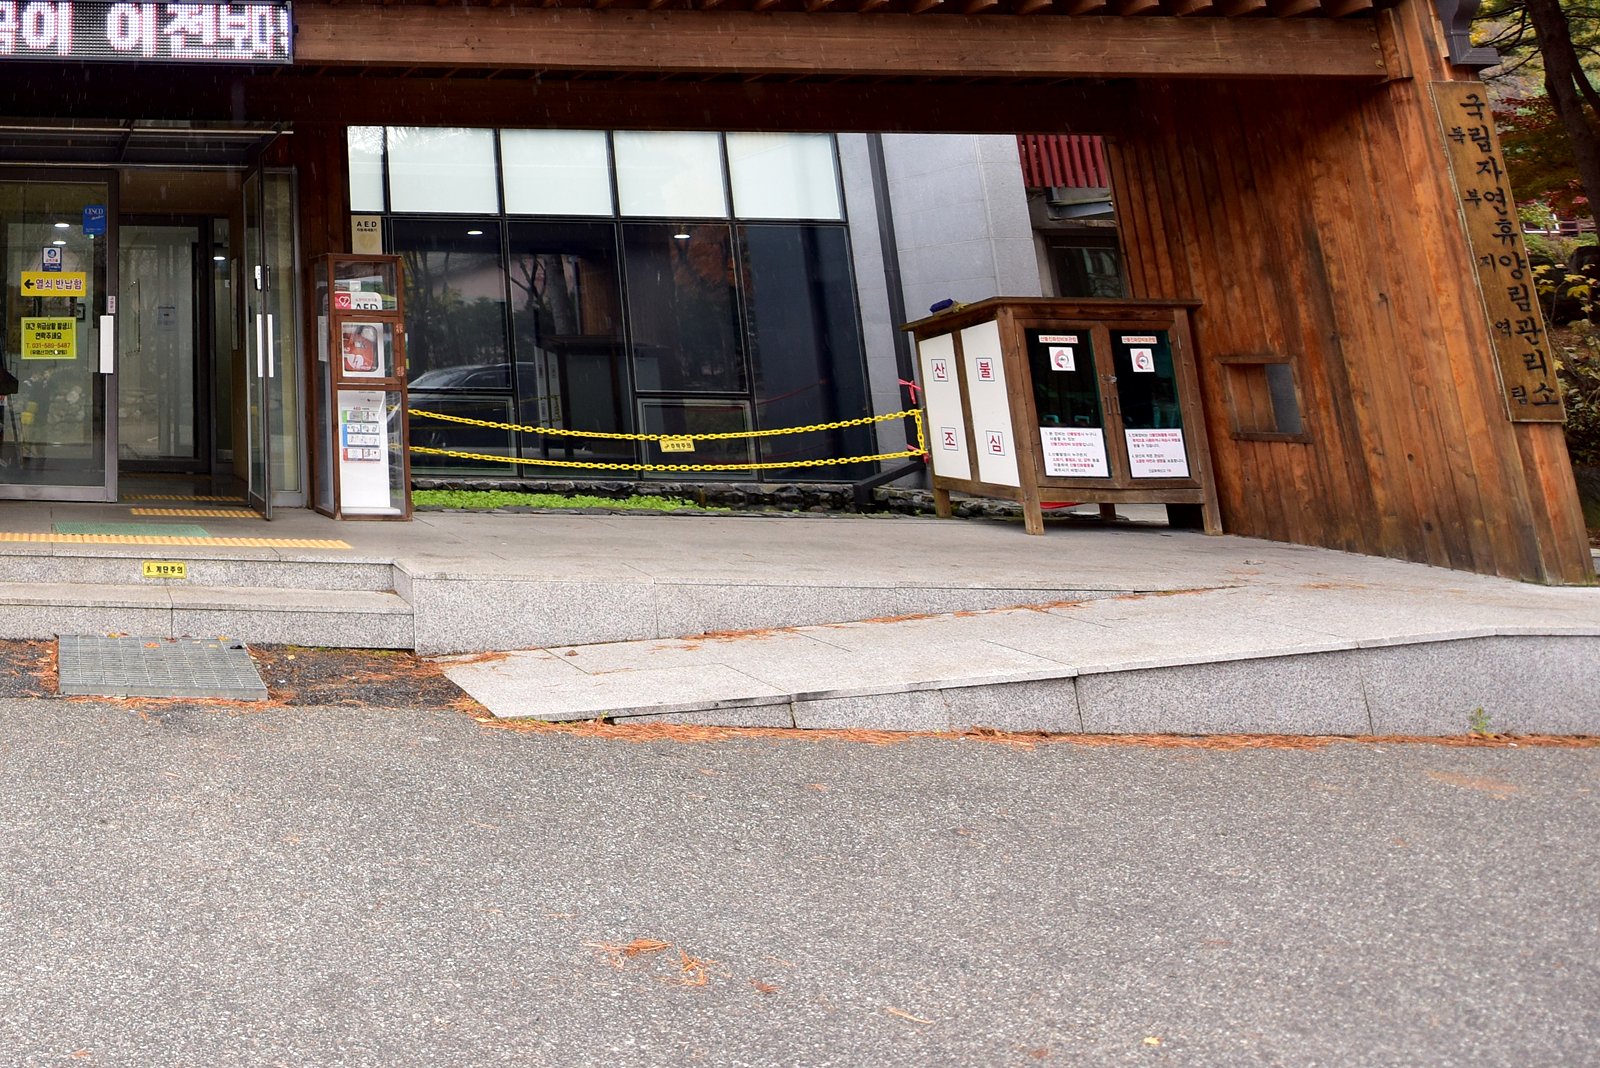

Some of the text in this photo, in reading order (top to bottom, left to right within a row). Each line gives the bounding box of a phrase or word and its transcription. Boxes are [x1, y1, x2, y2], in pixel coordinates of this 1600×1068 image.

[1460, 94, 1559, 407] 국립자연휴양림관리소
[36, 279, 82, 290] 열쇠 반납함
[934, 361, 991, 379] 산 불
[944, 432, 1002, 452] 조 심
[156, 566, 183, 574] 계단주의
